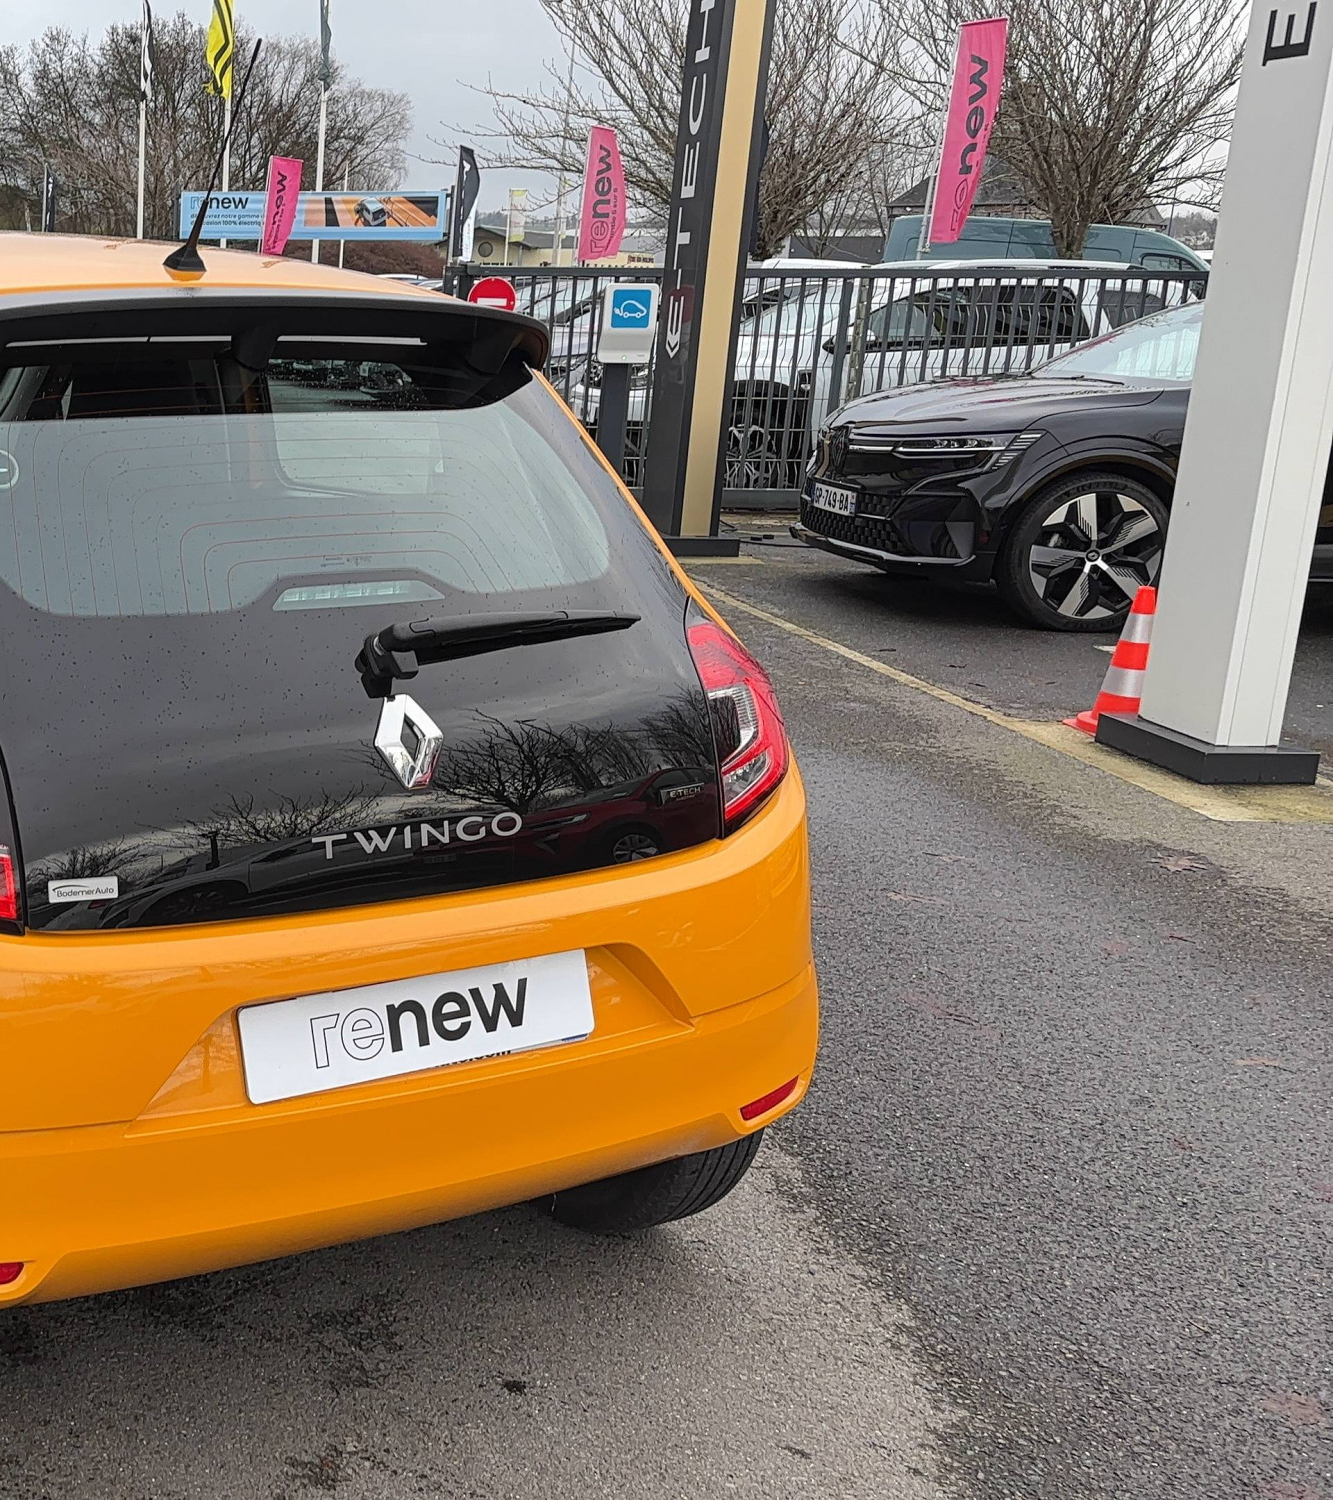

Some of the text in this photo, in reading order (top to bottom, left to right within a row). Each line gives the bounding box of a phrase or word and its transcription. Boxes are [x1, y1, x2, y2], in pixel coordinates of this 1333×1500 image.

[589, 144, 612, 254] renew
[311, 812, 523, 859] TWINGO
[309, 976, 528, 1069] renew
